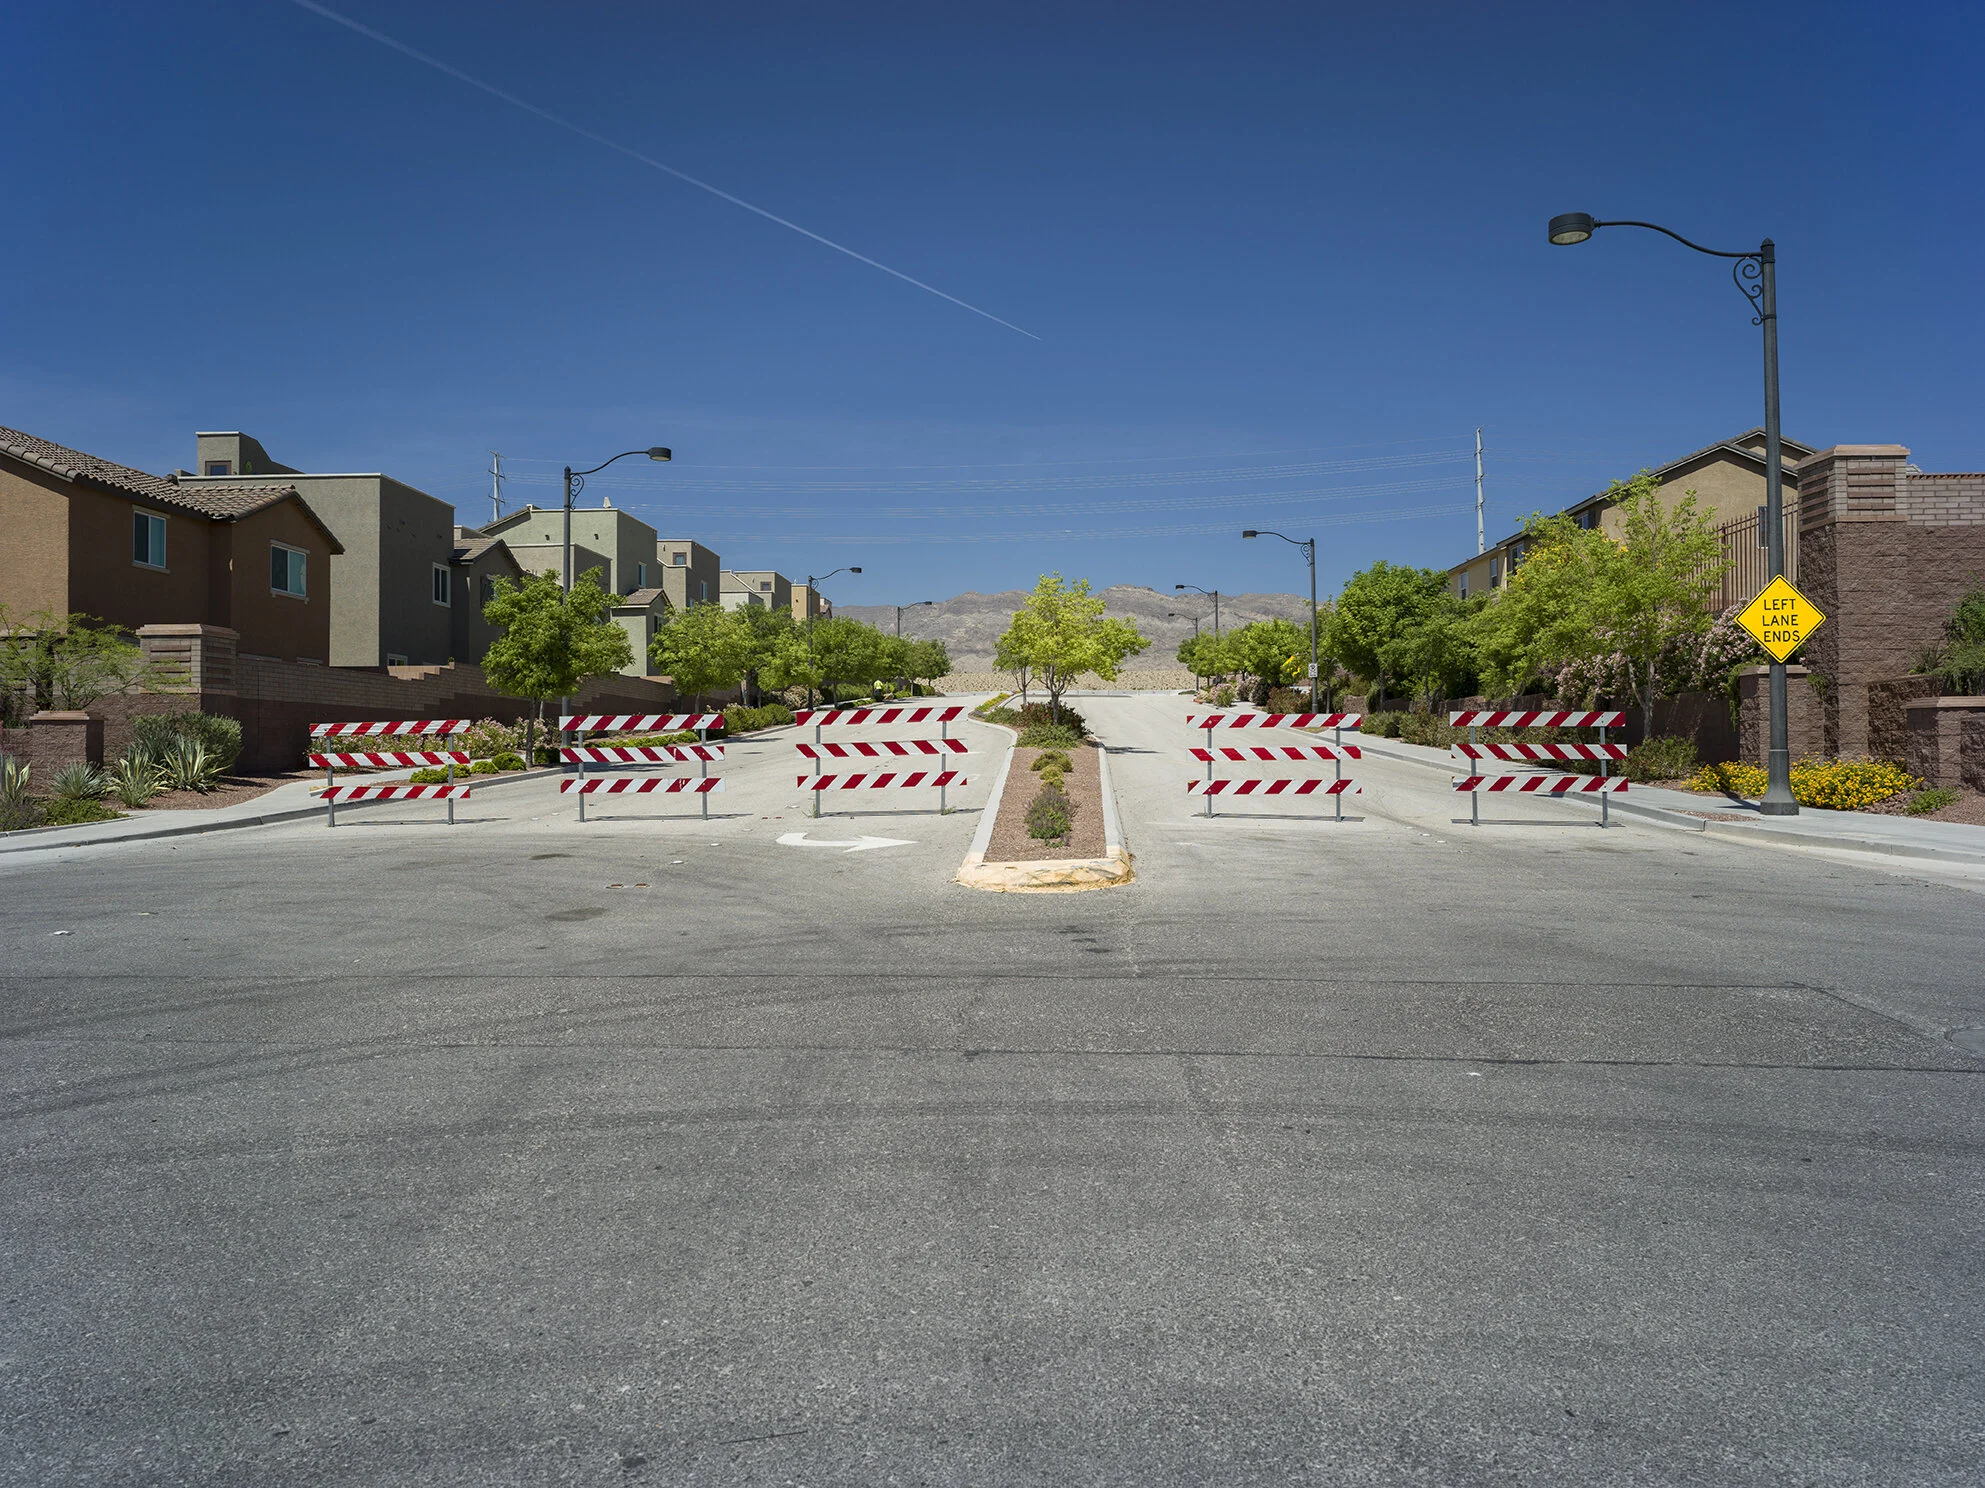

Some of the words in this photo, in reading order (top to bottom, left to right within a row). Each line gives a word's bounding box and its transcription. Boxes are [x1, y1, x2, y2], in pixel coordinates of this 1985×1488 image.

[1764, 599, 1796, 610] LEFT
[1762, 615, 1798, 626] LANE
[1764, 630, 1800, 642] ENDS
